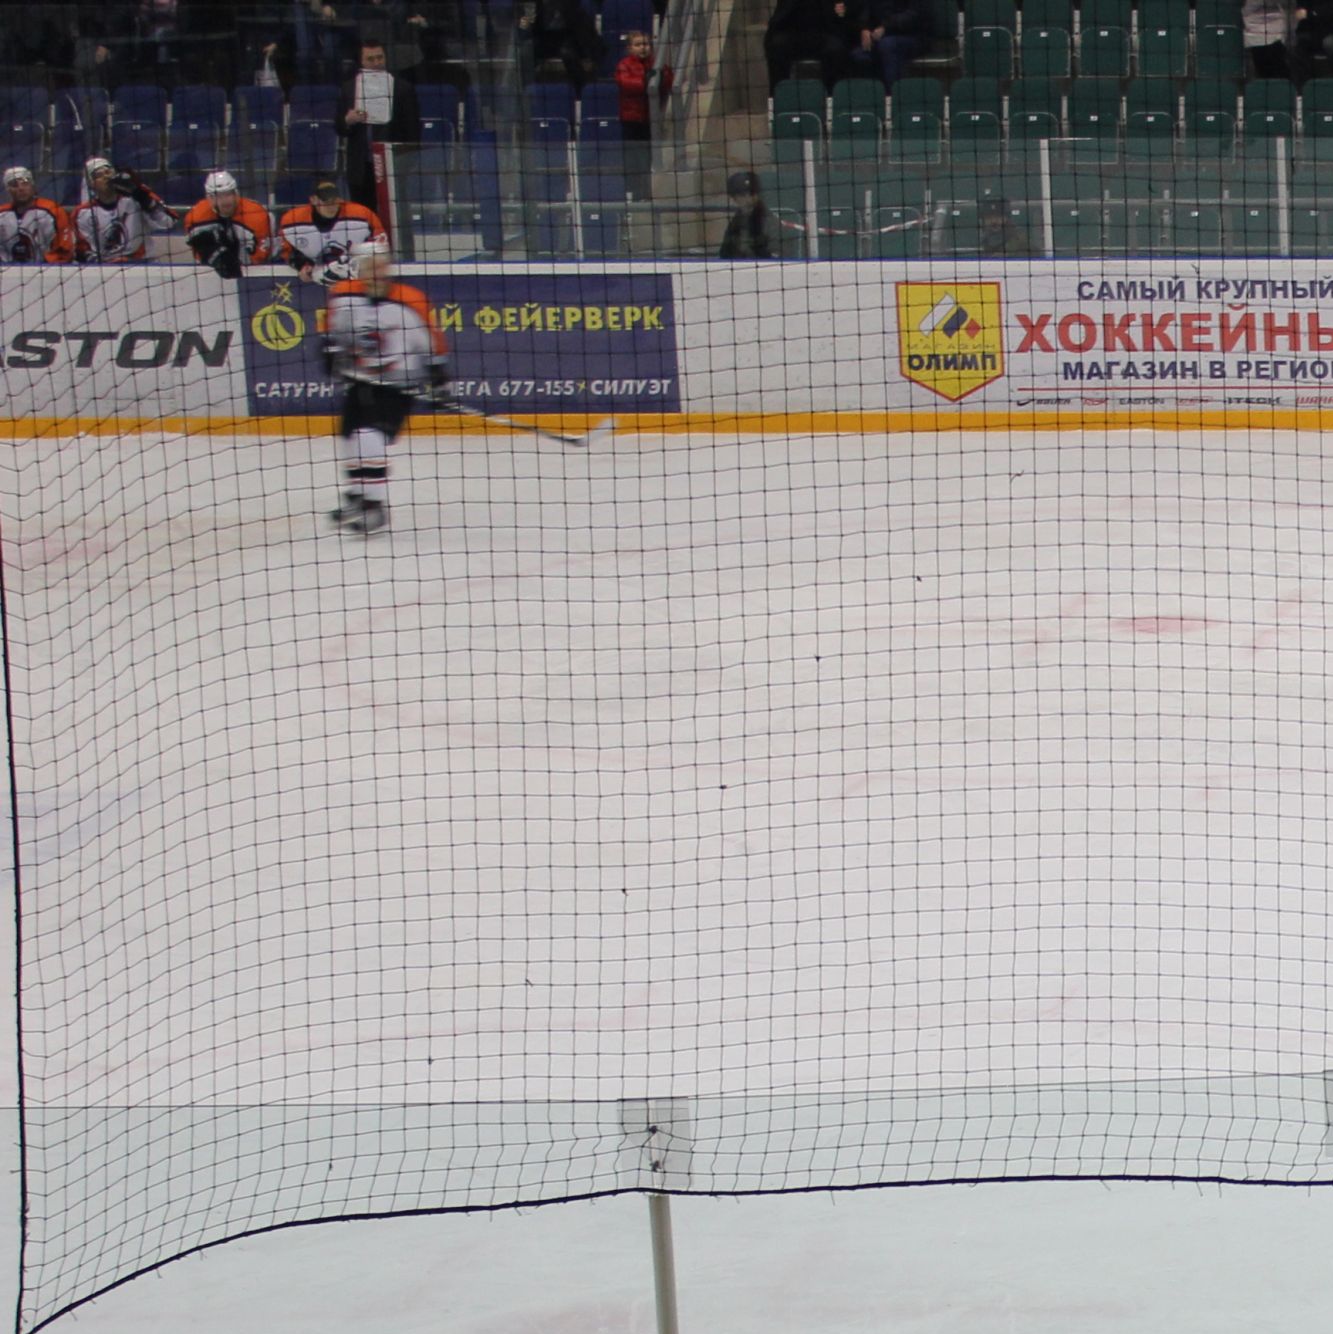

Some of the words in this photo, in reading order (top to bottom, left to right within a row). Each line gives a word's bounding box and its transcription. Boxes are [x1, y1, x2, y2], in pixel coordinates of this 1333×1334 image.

[1077, 275, 1185, 301] САМЫЙ
[473, 303, 665, 334] ФЕЙЕРВЕРК
[0, 331, 234, 368] STON
[908, 353, 997, 371] ОЛИМП
[1063, 361, 1198, 380] МАГАЗИН
[1209, 361, 1226, 379] В
[255, 381, 335, 398] САТУРН
[499, 380, 575, 397] 677-155
[590, 380, 672, 396] СИЛУЭТ
